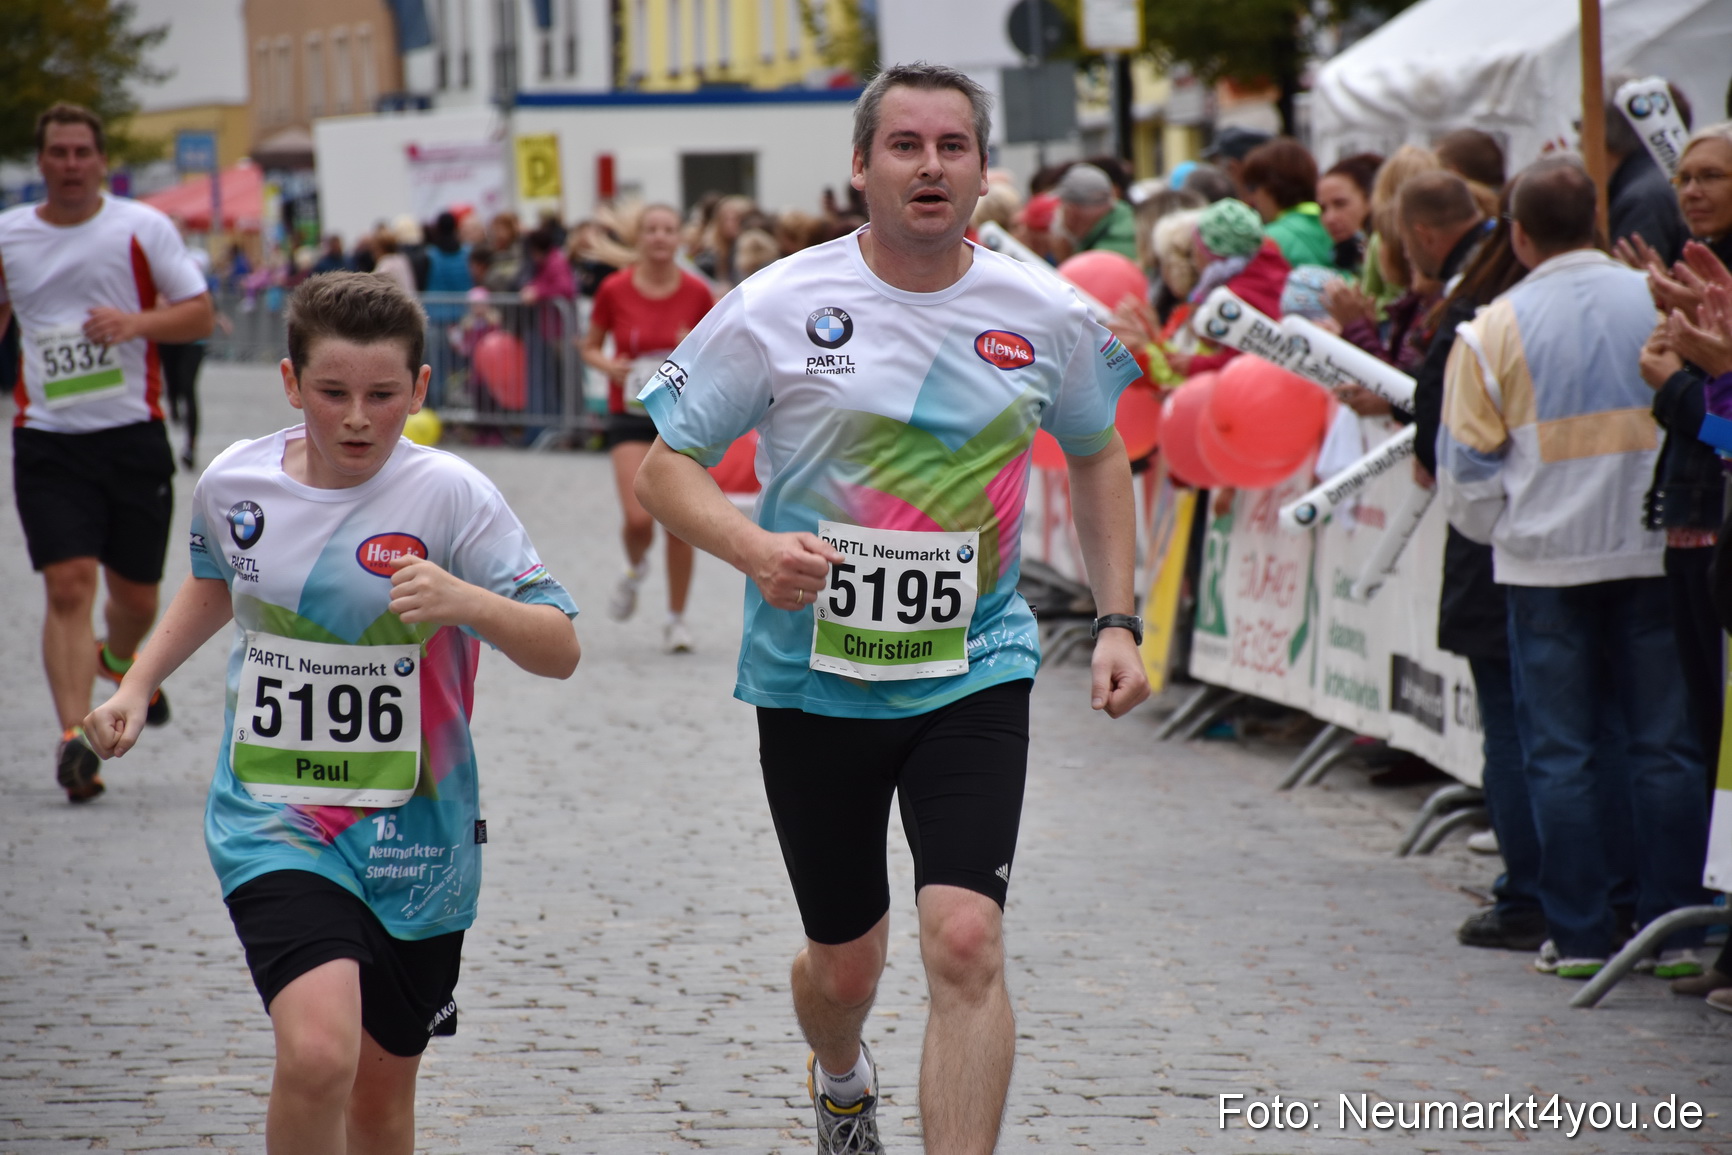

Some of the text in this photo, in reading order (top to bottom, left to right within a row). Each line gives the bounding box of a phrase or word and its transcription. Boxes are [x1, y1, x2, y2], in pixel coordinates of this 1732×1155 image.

[810, 308, 849, 322] BMW
[43, 342, 114, 377] 5332
[983, 337, 1029, 360] Hervis
[805, 366, 856, 375] Neumarkt
[806, 354, 855, 367] PARTL
[230, 502, 262, 519] BMW
[822, 536, 951, 562] PARTL Neumarkt
[231, 555, 259, 572] PARTL
[829, 563, 962, 624] 5195
[844, 634, 933, 660] Christian
[248, 647, 387, 676] PARTL Neumarkt
[252, 676, 403, 743] 5196
[296, 758, 348, 782] Paul
[369, 843, 446, 859] Neumarkter
[365, 863, 428, 880] Stadtlauf
